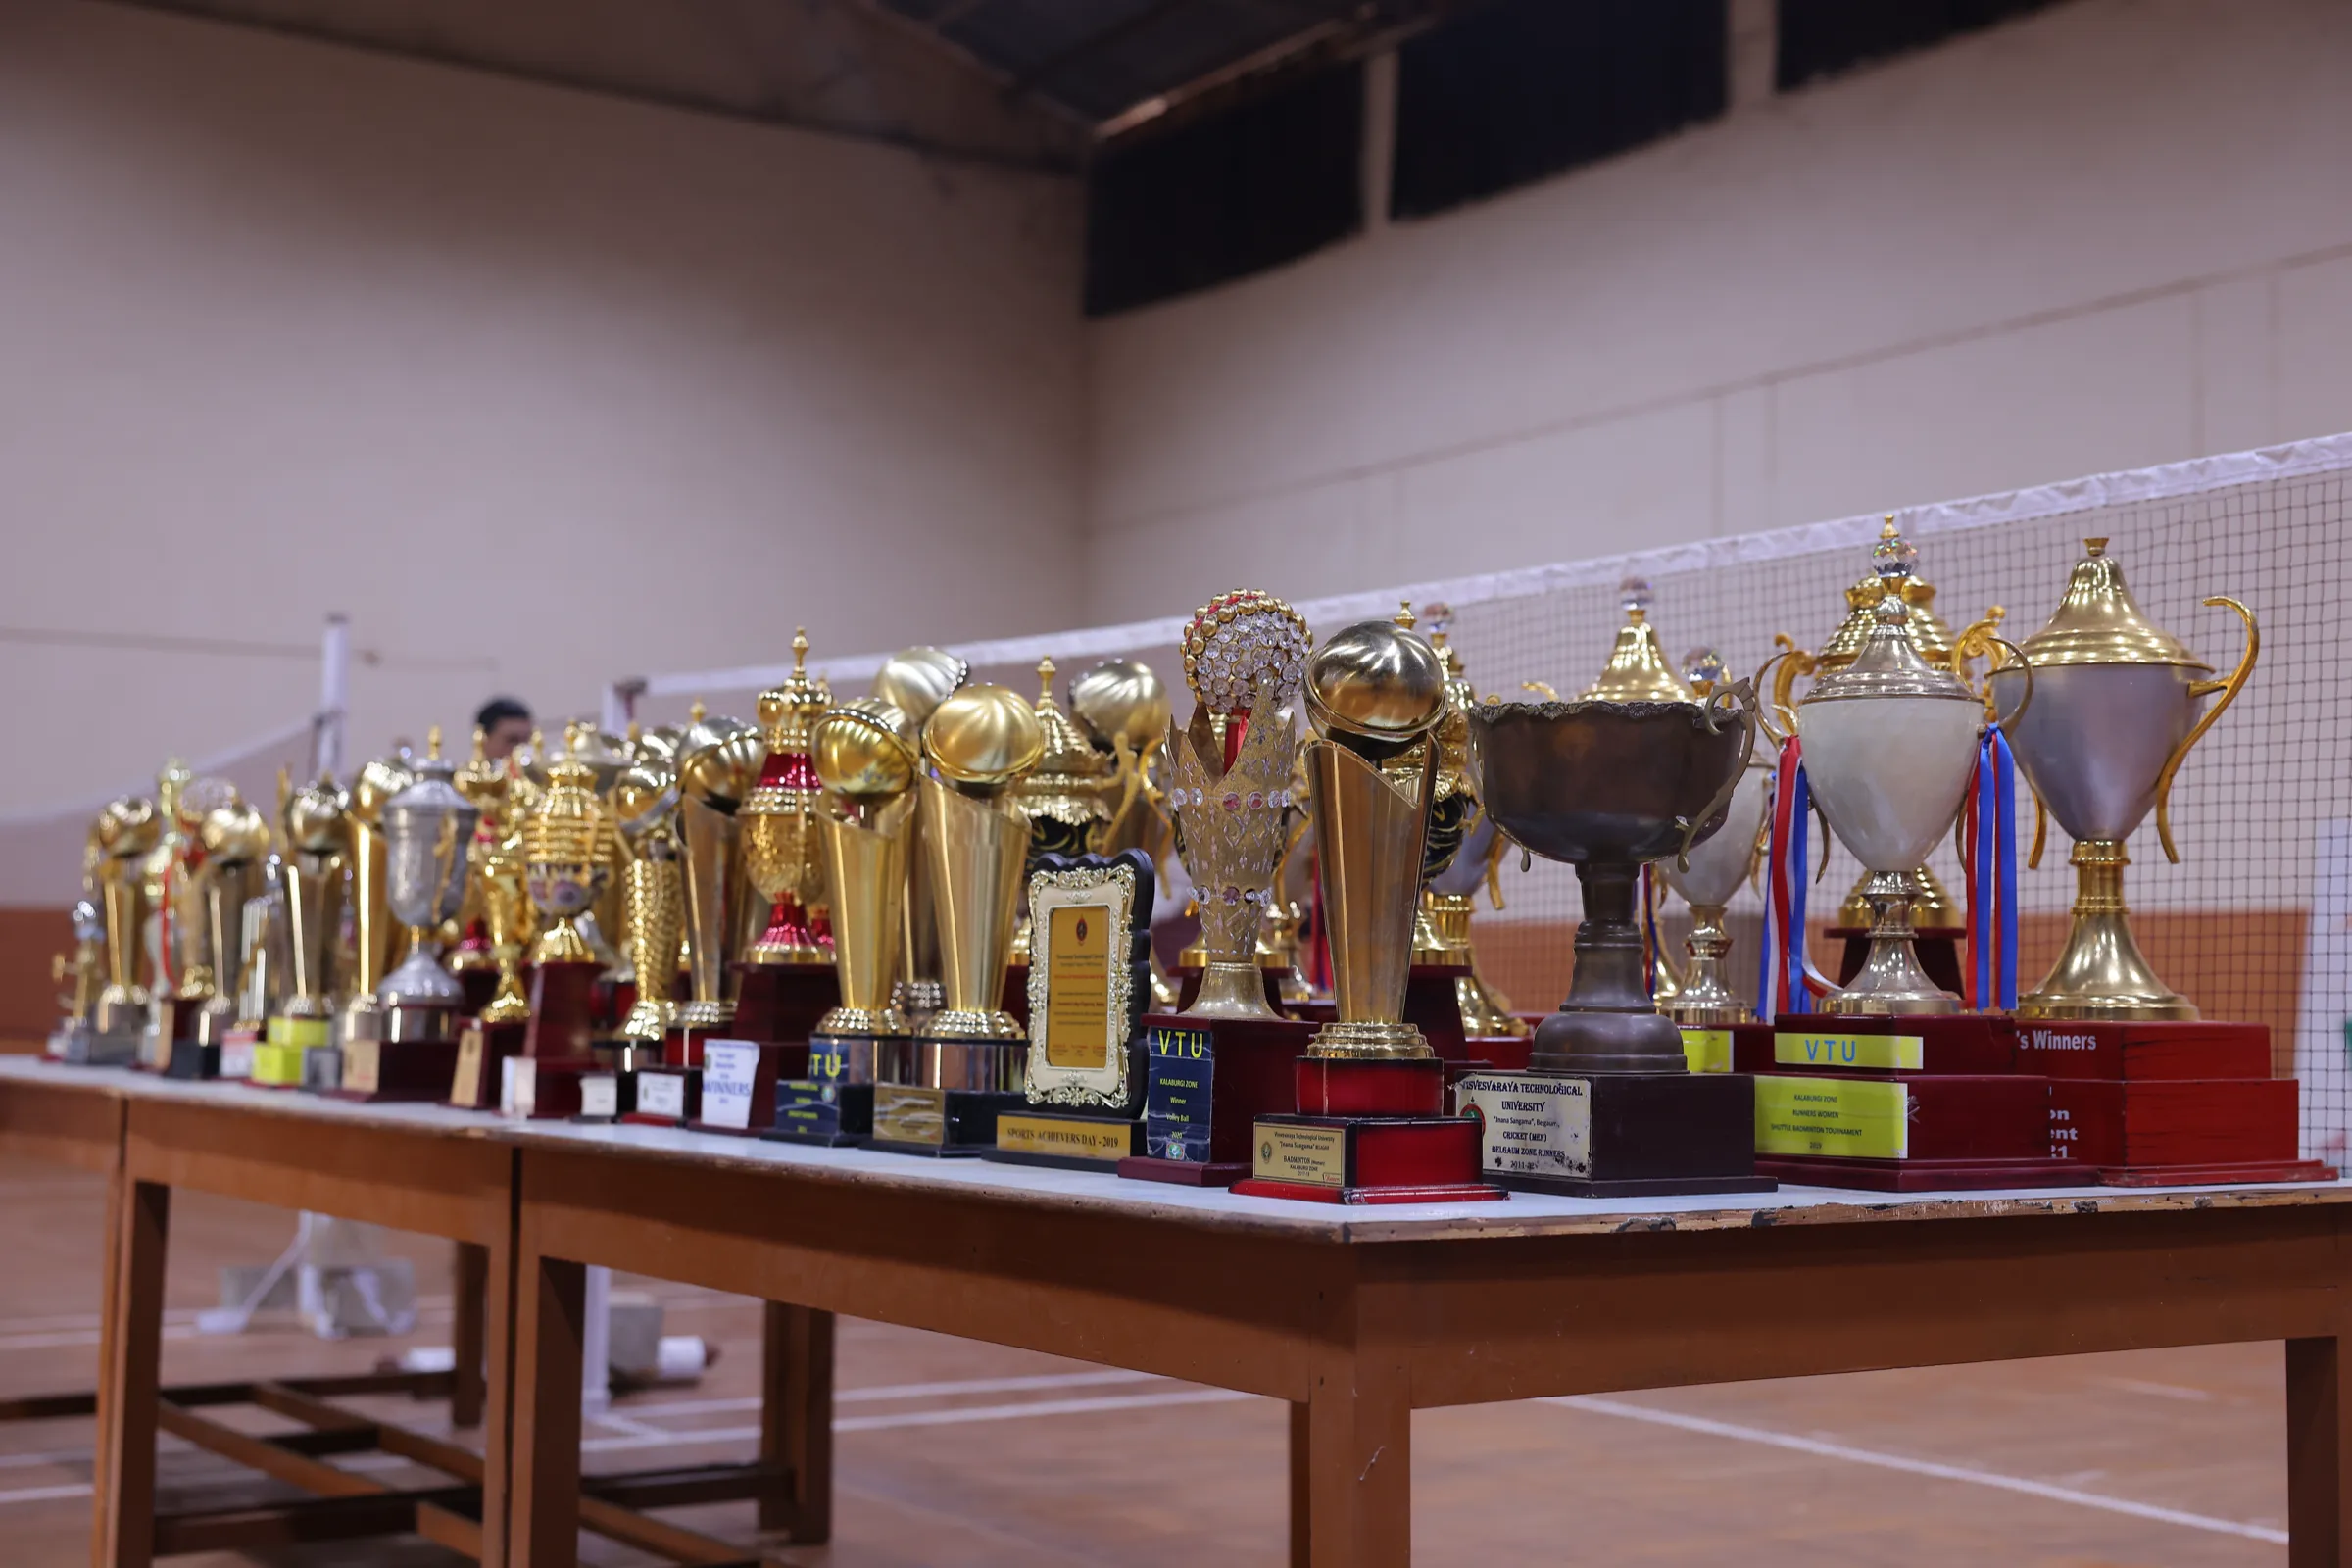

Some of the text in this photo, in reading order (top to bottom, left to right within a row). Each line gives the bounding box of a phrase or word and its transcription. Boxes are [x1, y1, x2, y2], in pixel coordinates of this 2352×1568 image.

[1158, 1029, 1203, 1058] VTU
[2033, 1030, 2097, 1050] Winners
[1804, 1039, 1856, 1062] VTU
[812, 1054, 841, 1077] TU
[703, 1081, 751, 1097] WINNERS
[1159, 1077, 1198, 1089] KALABURGI ZONE
[1520, 1083, 1583, 1096] TECHNOLOGICAL
[1169, 1096, 1187, 1105] Winner
[1793, 1094, 1838, 1103] KALABURGI ZONE
[1501, 1100, 1546, 1112] UNIVERSITY
[1165, 1113, 1190, 1123] Volley Ball
[1792, 1109, 1839, 1119] RUNNERS WOMEN
[1771, 1123, 1862, 1137] SHUTTLE BADMINTON TOURNAMENT
[1007, 1128, 1035, 1140] SPORTS
[1038, 1130, 1080, 1144] ACHIEVERS
[1081, 1134, 1098, 1147] DAY
[1102, 1136, 1119, 1148] 2019
[1502, 1131, 1547, 1142] CRICKET (MEN)
[1492, 1145, 1565, 1157] BELGAUM ZONE RUNNERS
[1284, 1155, 1310, 1164] BADMINTON
